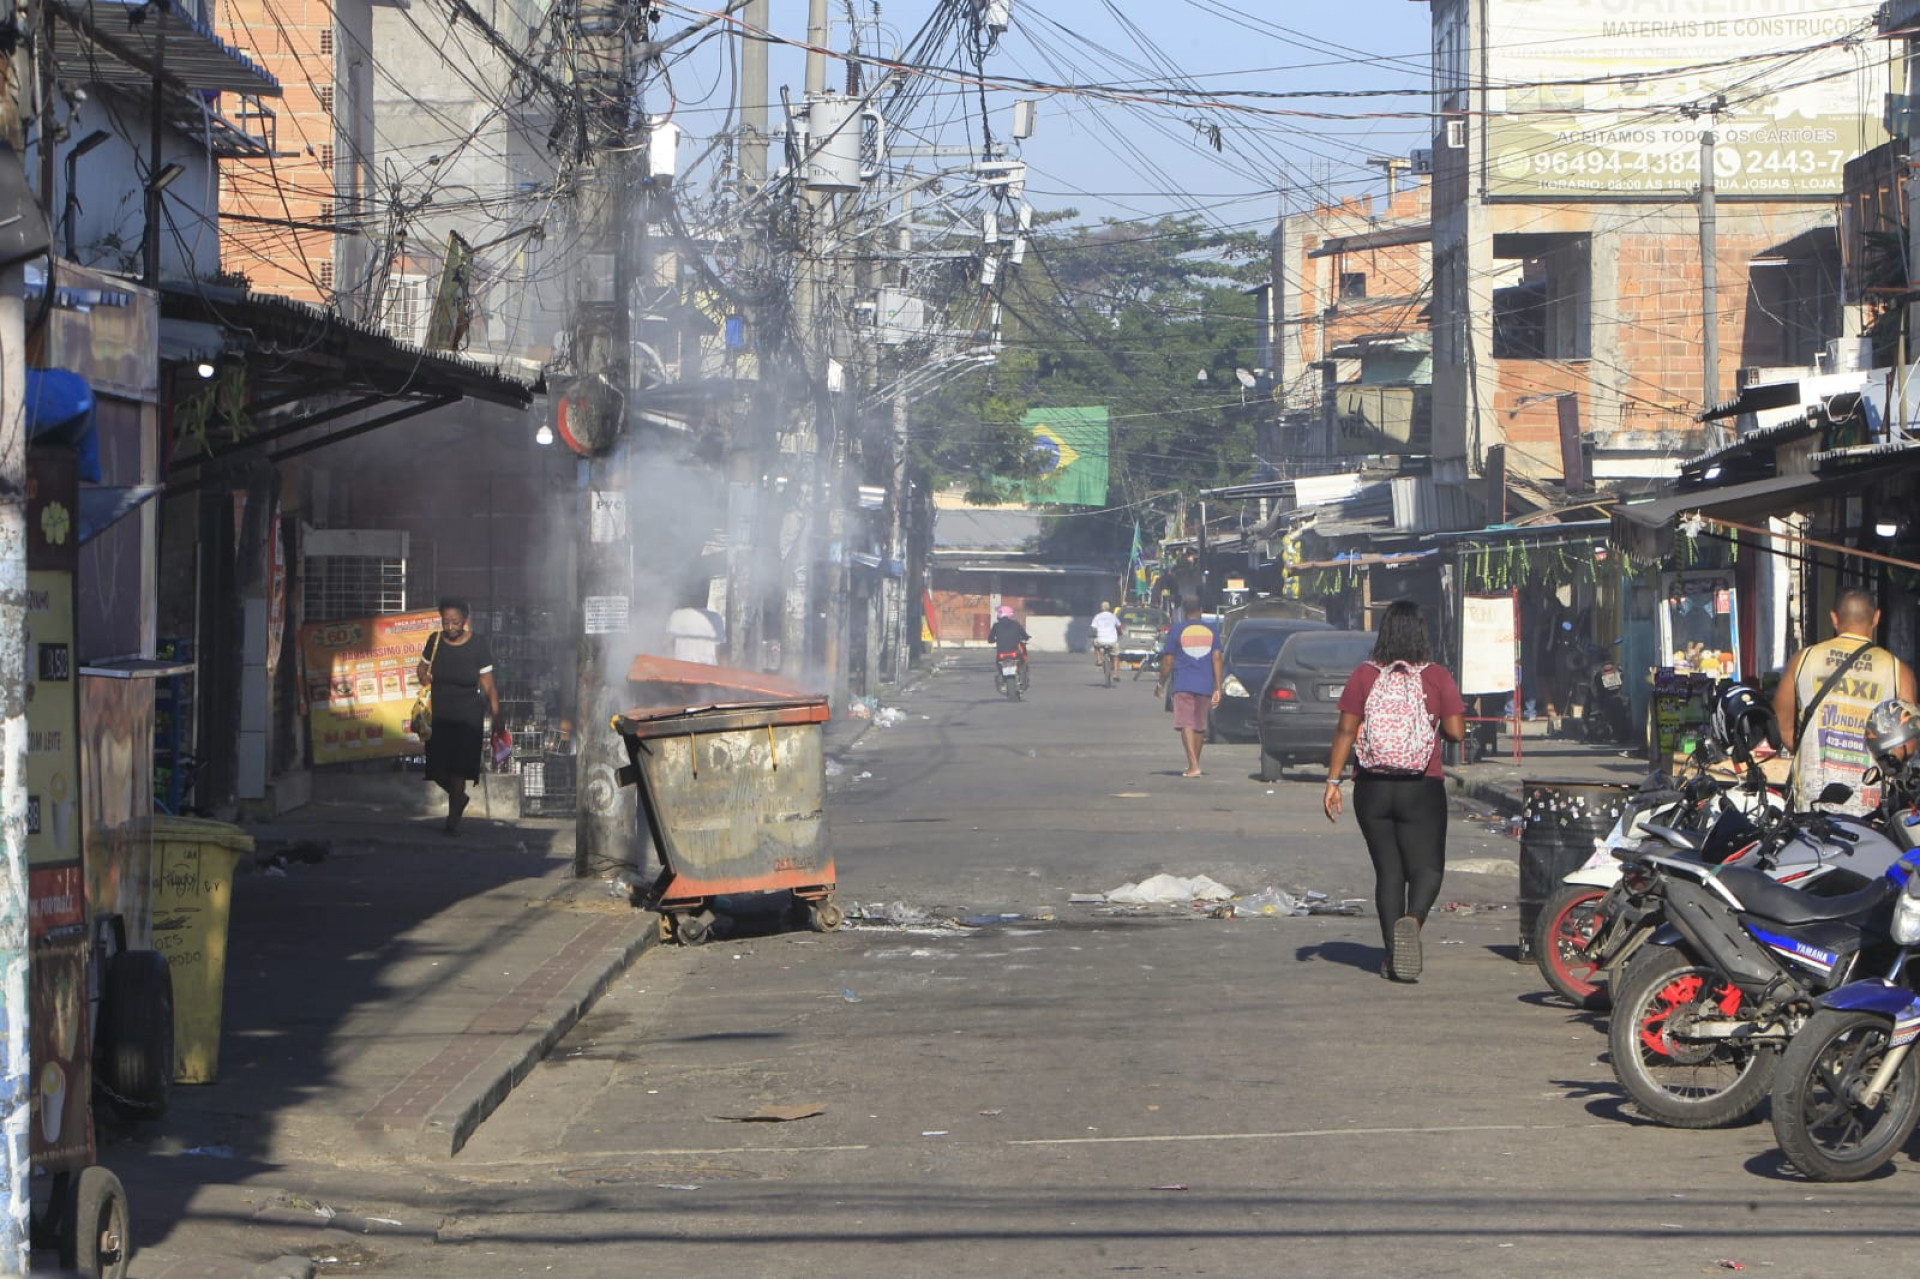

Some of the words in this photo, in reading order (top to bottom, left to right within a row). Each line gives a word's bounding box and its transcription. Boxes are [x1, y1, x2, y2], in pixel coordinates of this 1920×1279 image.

[1602, 20, 1698, 38] MATERIAIS
[1704, 20, 1727, 37] DE
[1557, 130, 1656, 143] ACEITAMOS
[1726, 130, 1749, 142] OS
[1755, 125, 1836, 143] CARTÕES
[1534, 150, 1700, 174] 96494-4384
[1746, 149, 1860, 174] 2443-7
[1742, 179, 1790, 189] JOSIAS
[1801, 178, 1836, 189] LOJA
[1830, 649, 1872, 661] MOO
[1826, 657, 1872, 672] PRÇA
[1823, 704, 1866, 728] MUNDIA
[1796, 943, 1827, 962] YAMAHA
